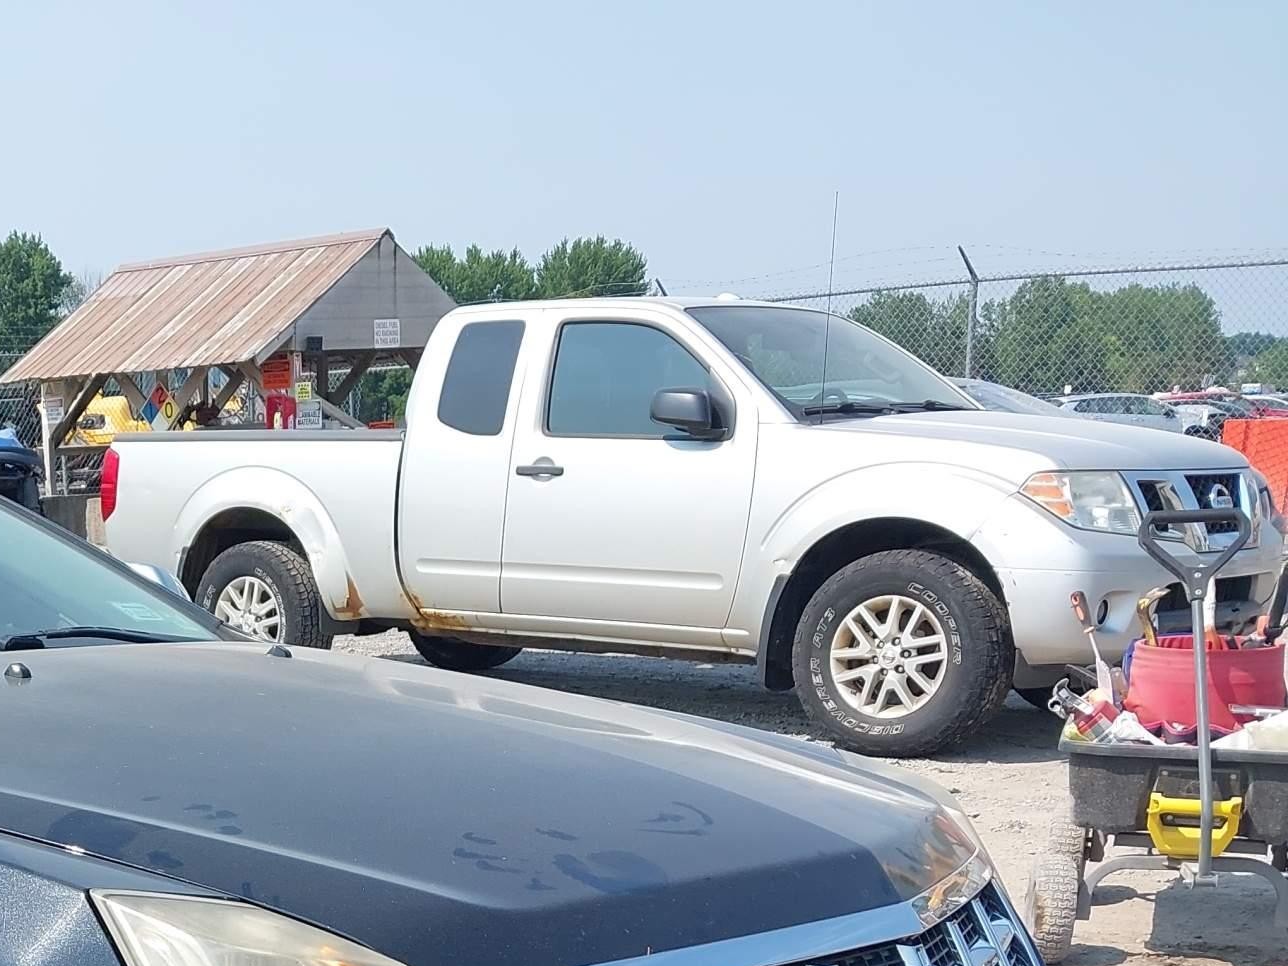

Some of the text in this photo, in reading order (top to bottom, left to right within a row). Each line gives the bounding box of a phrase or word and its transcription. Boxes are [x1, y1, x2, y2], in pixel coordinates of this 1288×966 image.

[156, 386, 166, 405] 2
[164, 402, 173, 419] 0
[907, 582, 962, 665] COOPER
[810, 607, 904, 735] DISCOVERER AT3
